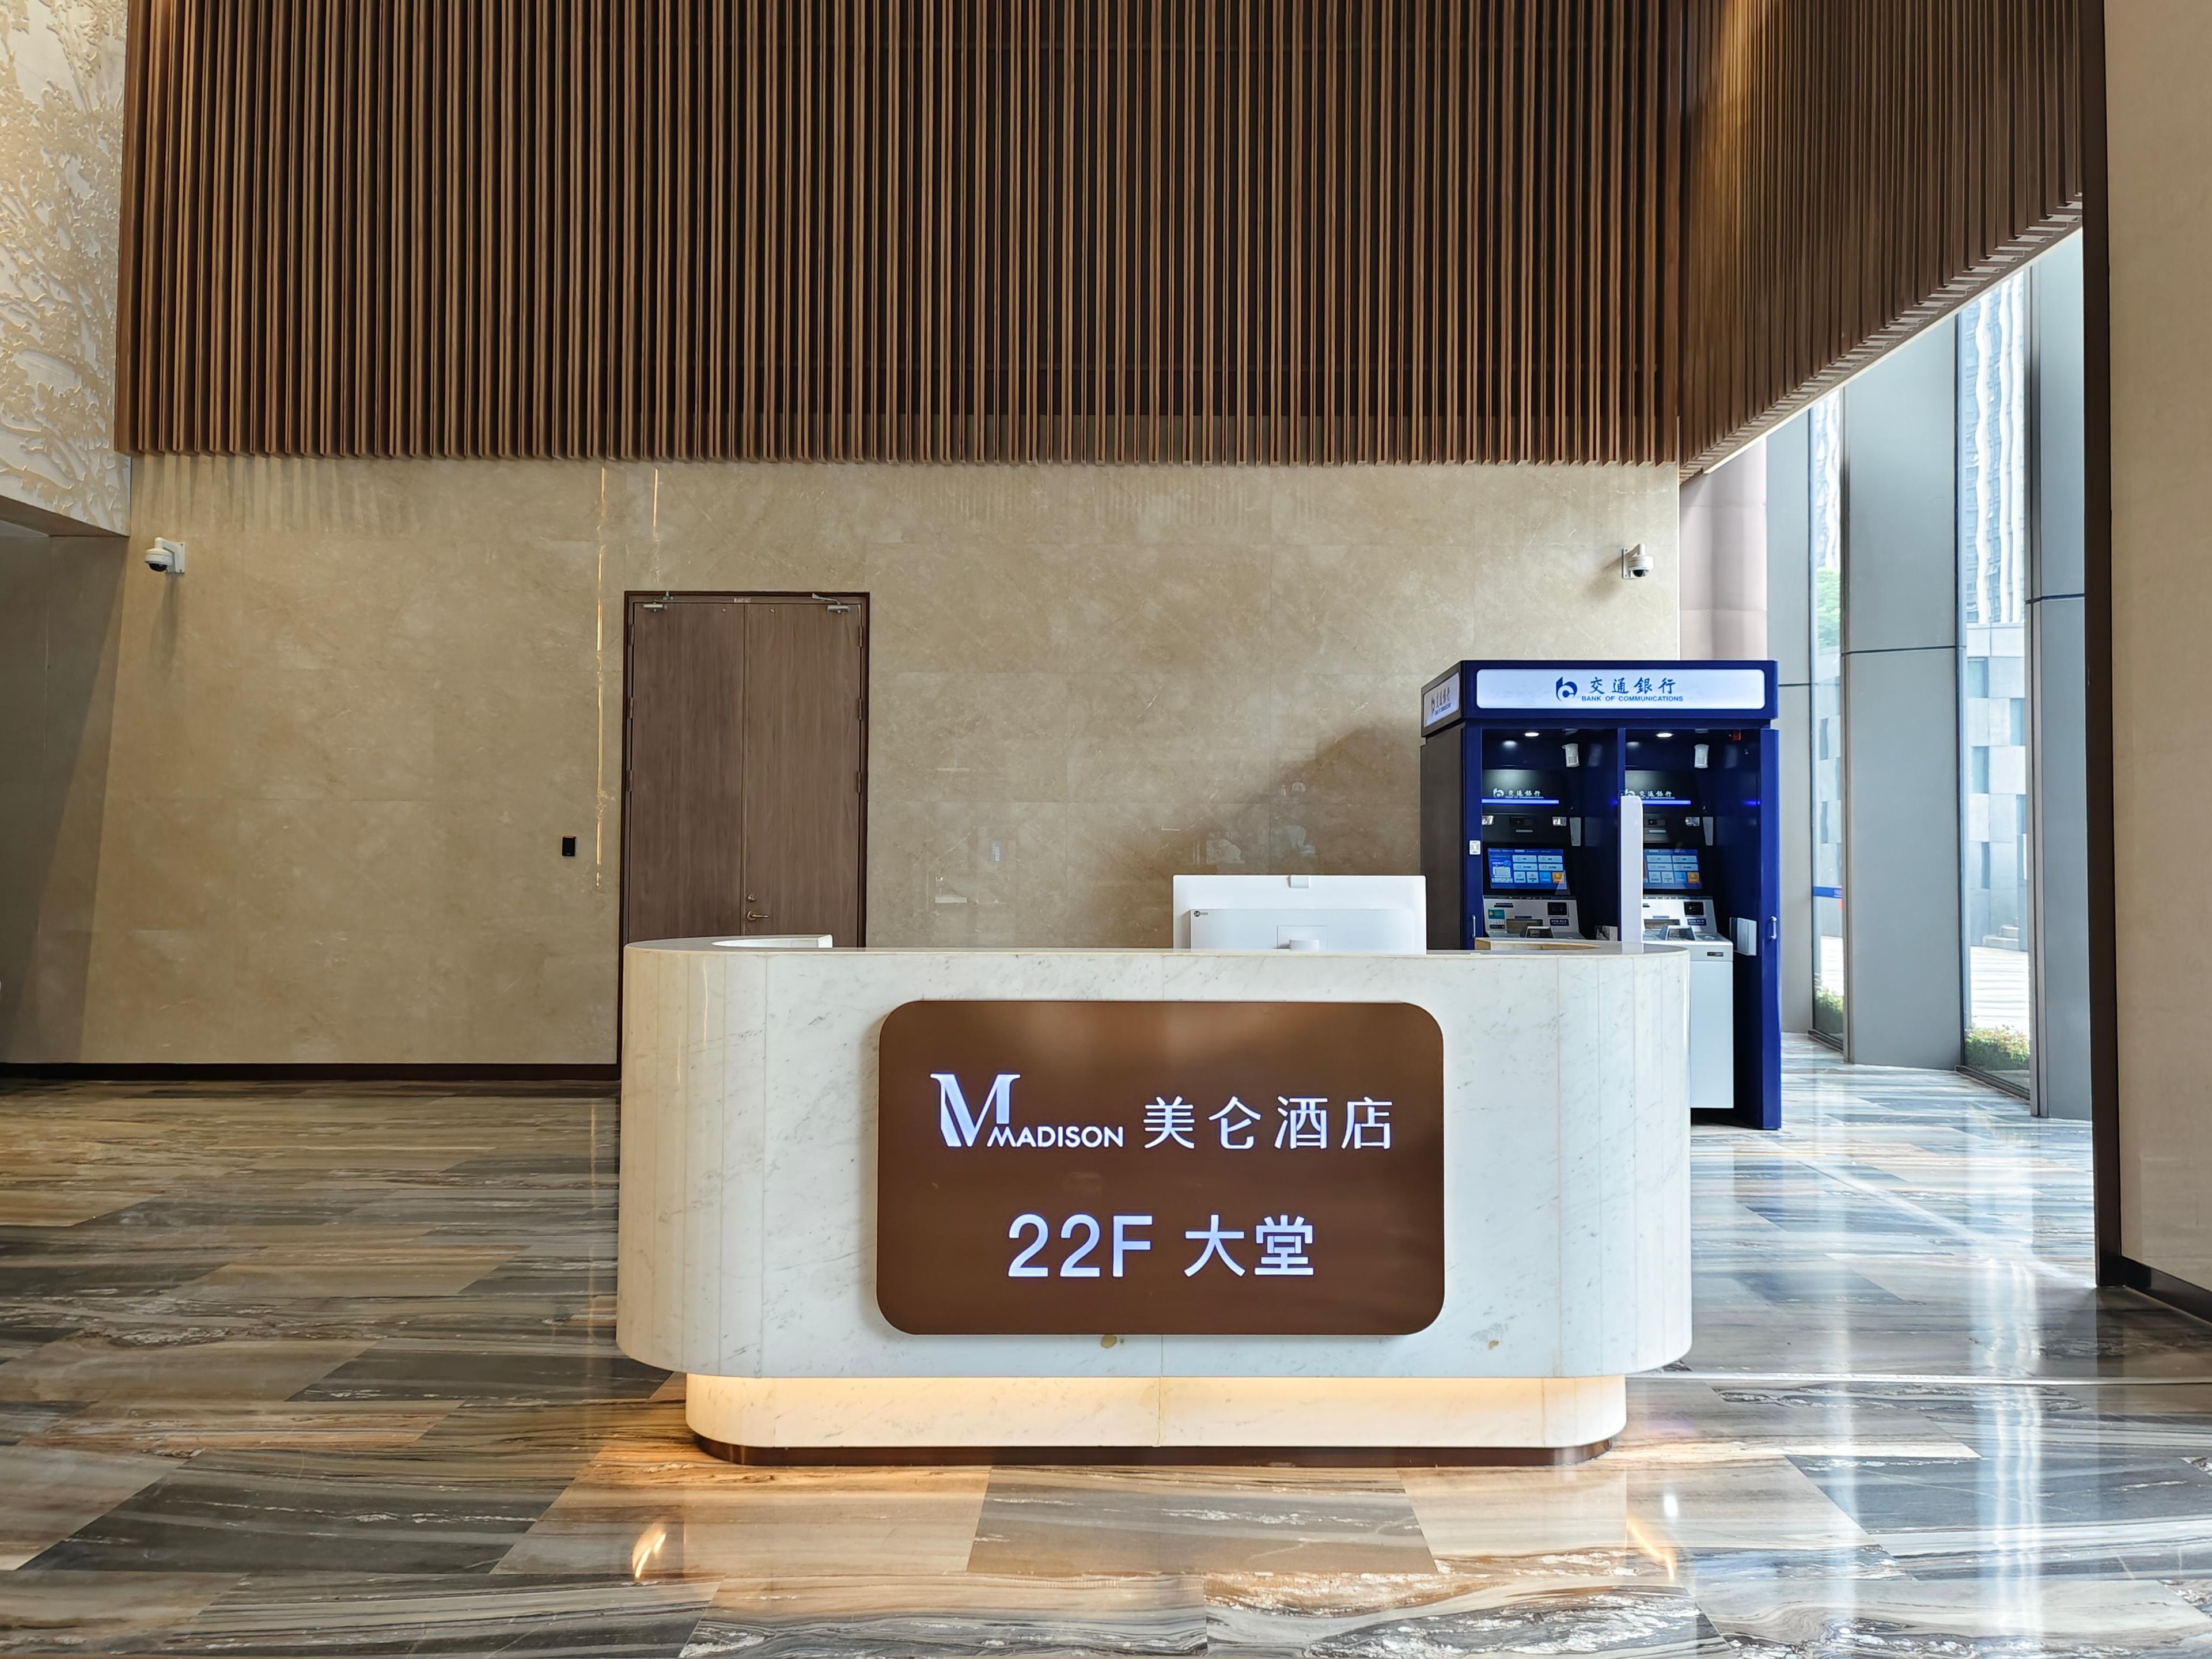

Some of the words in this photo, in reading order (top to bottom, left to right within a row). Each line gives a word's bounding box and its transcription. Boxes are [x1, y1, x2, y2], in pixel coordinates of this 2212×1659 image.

[1588, 676, 1676, 694] 交通銀行
[987, 1126, 1123, 1148] MADISON
[1143, 1095, 1393, 1149] 美仑酒店
[1007, 1214, 1153, 1277] 22F
[1184, 1214, 1314, 1277] 大堂
